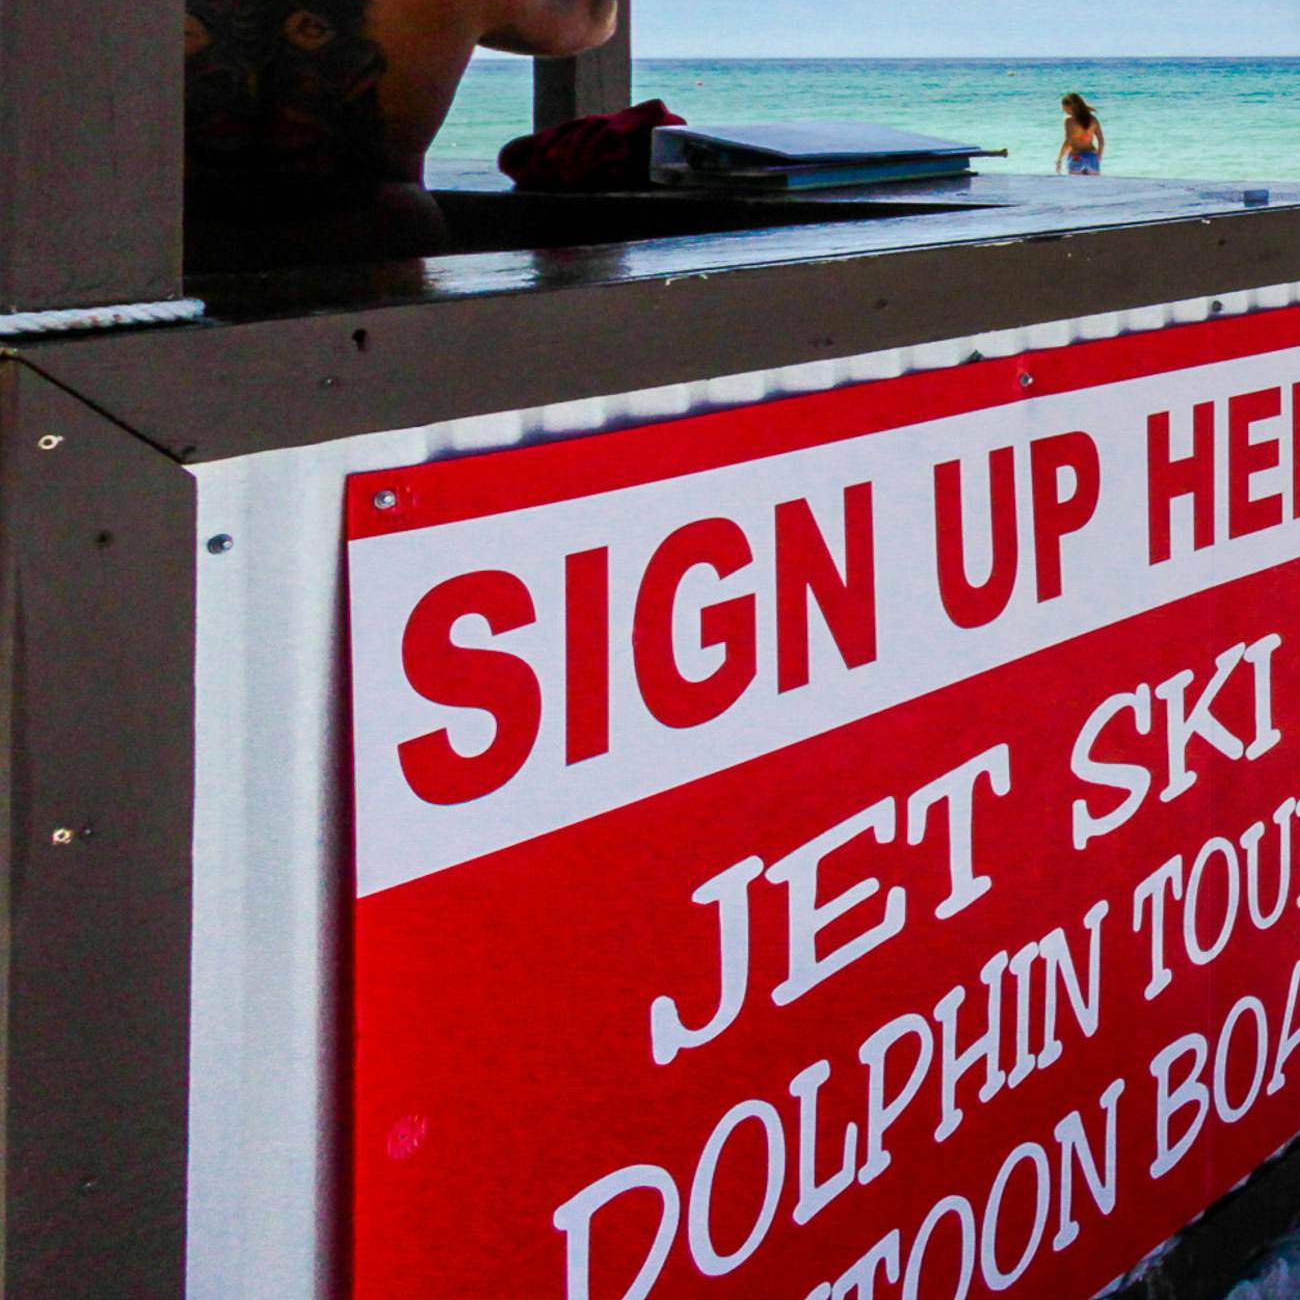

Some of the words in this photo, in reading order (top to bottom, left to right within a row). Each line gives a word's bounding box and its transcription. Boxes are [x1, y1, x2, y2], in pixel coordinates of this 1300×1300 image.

[397, 480, 877, 807] SIGN
[933, 430, 1101, 630] UP
[650, 742, 1010, 1066] JET
[1071, 633, 1282, 850] SKI
[553, 900, 1109, 1300] DOLPHIN
